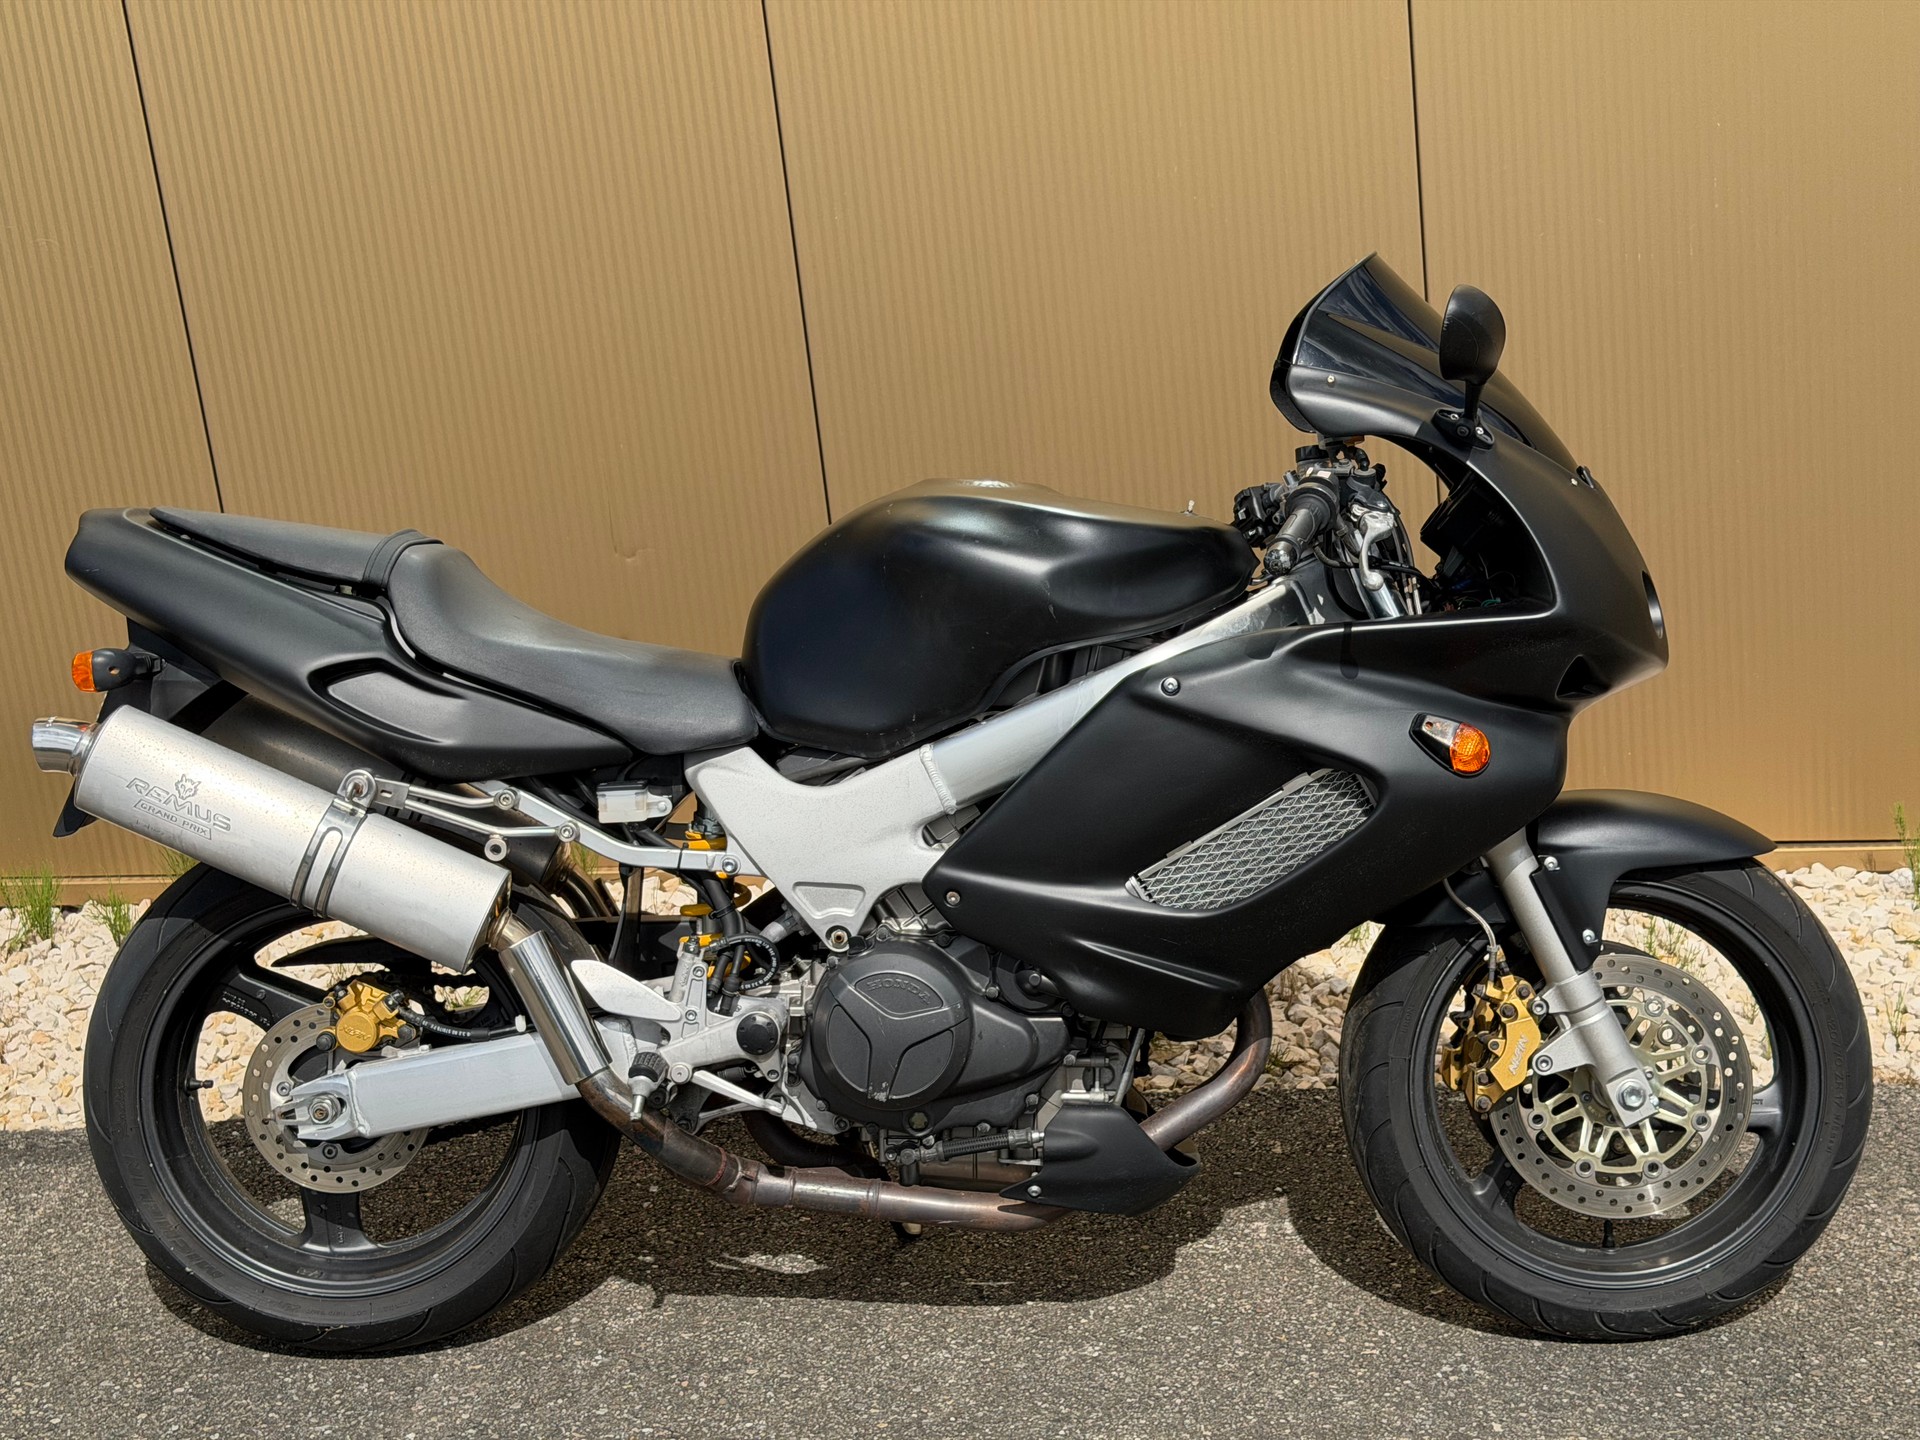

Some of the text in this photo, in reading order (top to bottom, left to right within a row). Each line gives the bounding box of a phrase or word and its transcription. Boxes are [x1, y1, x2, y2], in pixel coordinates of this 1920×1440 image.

[126, 777, 231, 832] REMUS
[140, 802, 178, 823] GRAND
[181, 819, 208, 836] PRIX
[866, 978, 931, 1005] HONDA
